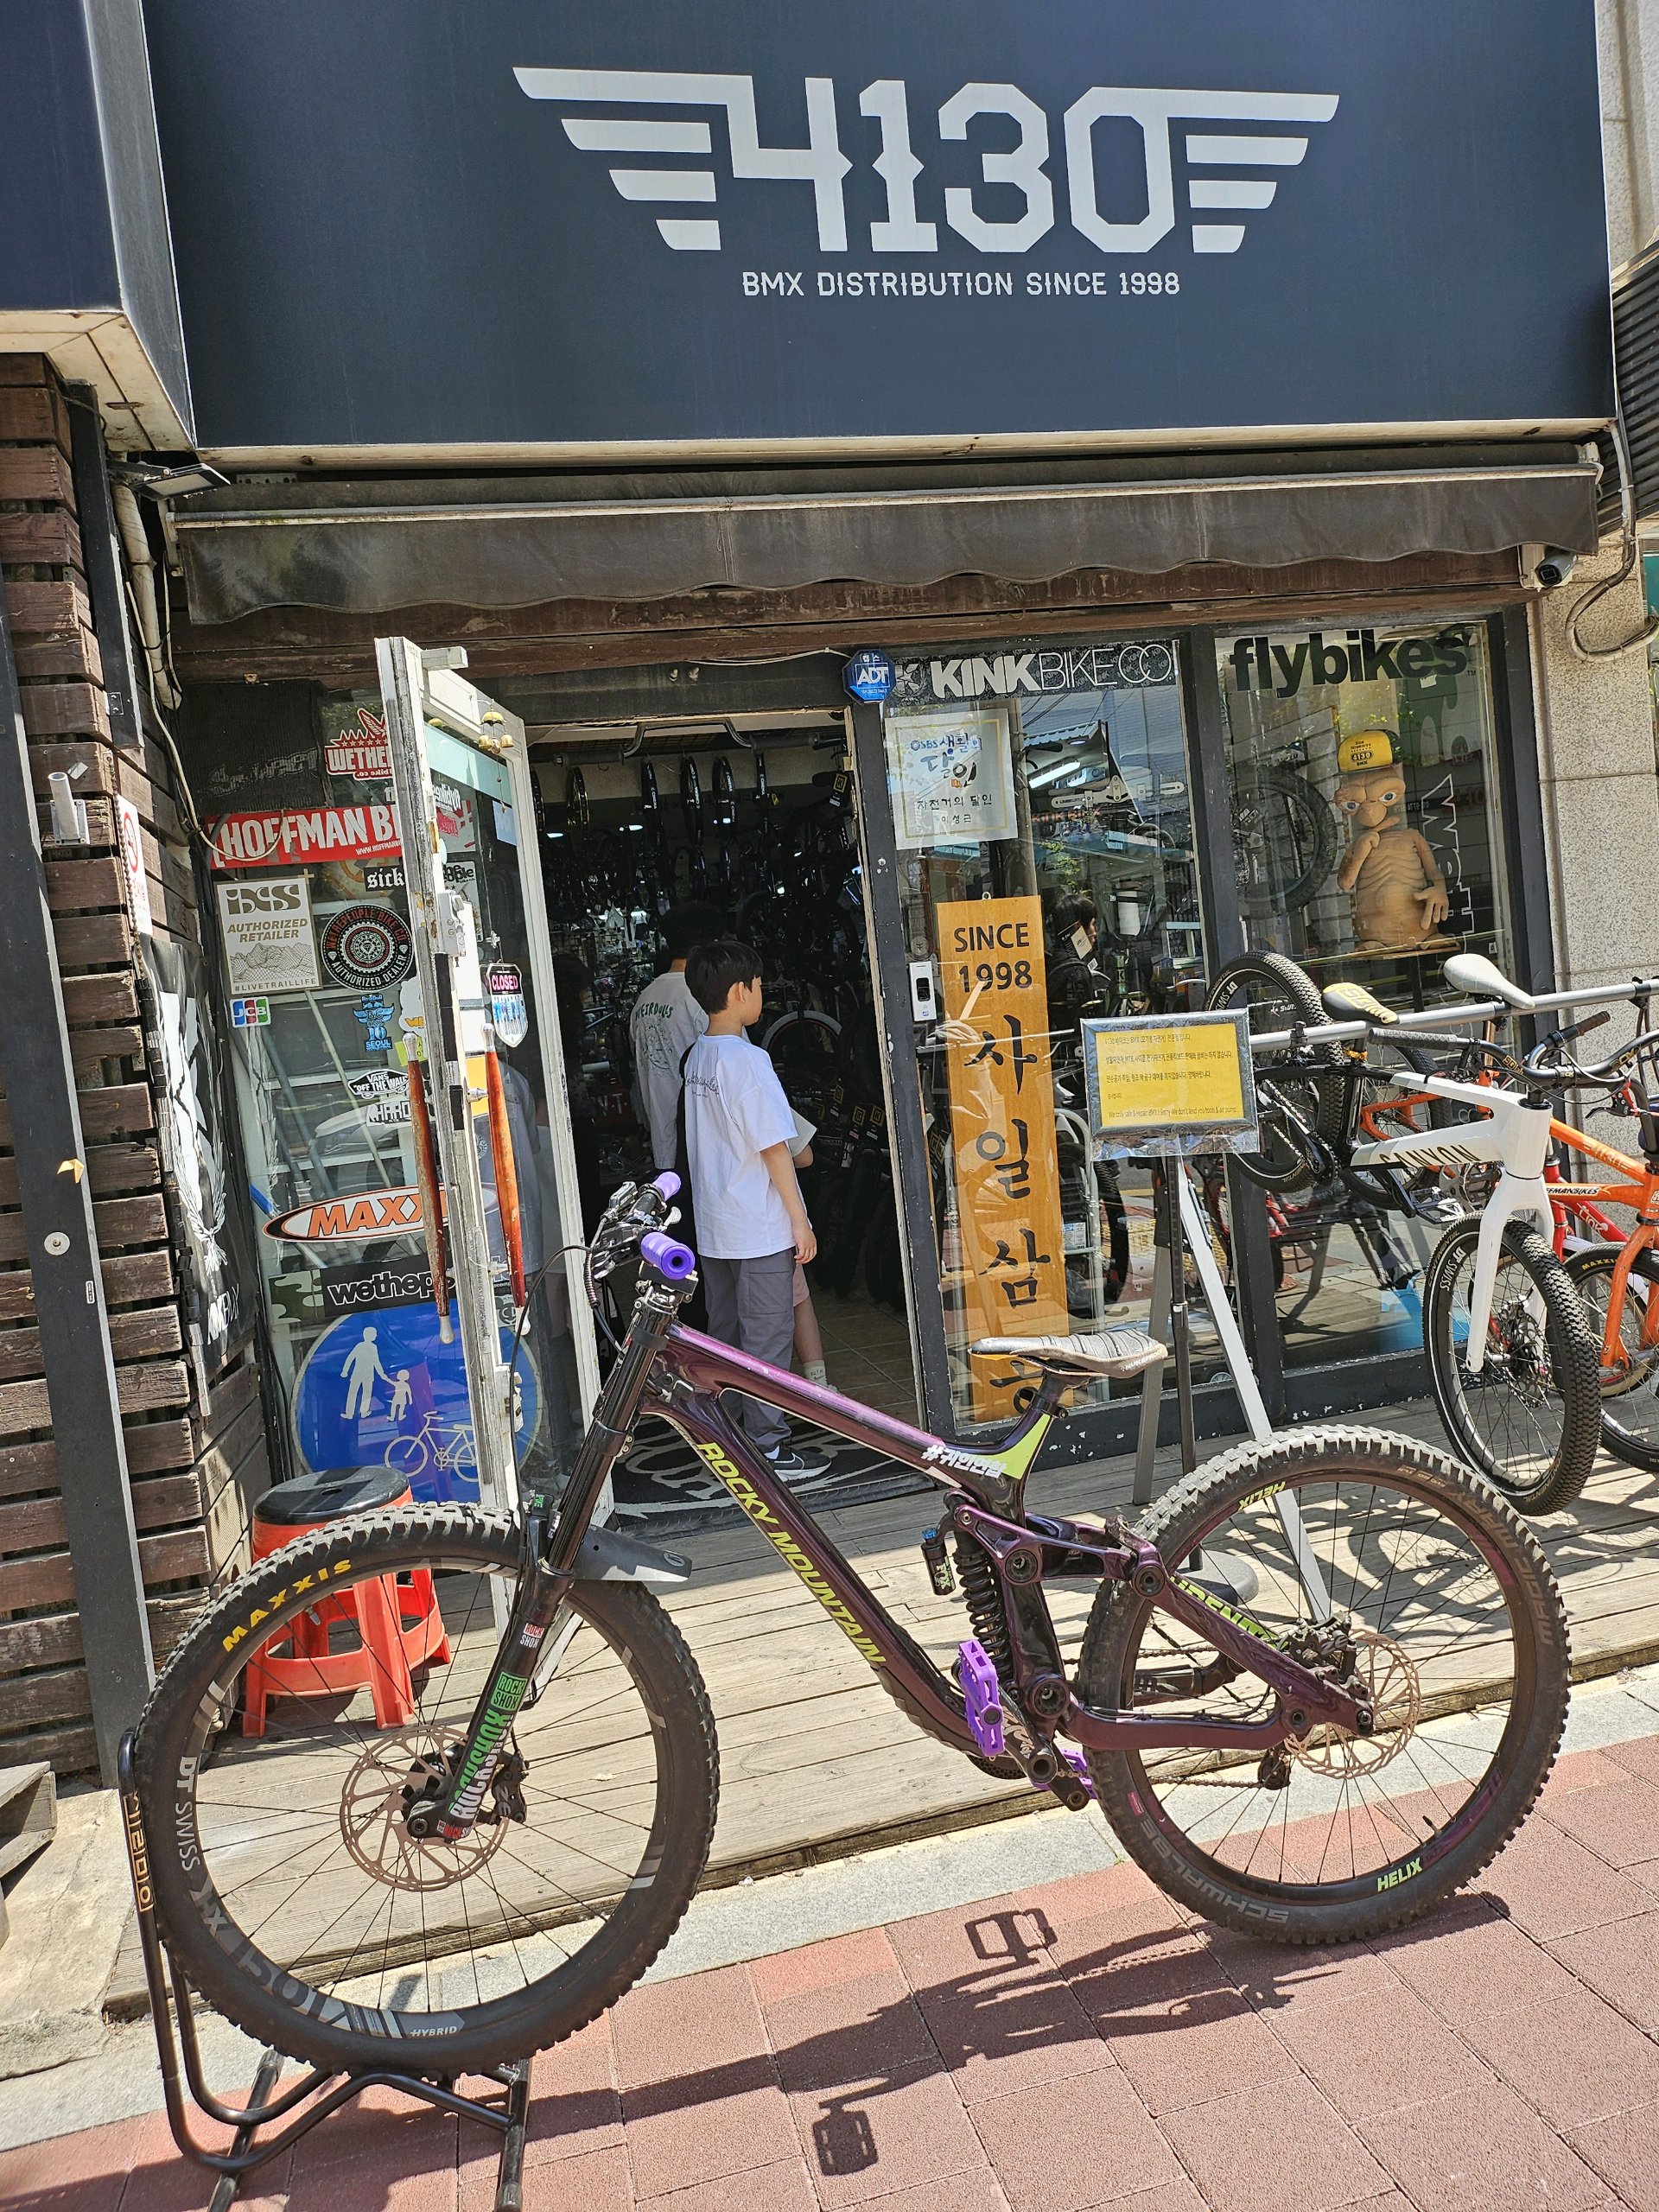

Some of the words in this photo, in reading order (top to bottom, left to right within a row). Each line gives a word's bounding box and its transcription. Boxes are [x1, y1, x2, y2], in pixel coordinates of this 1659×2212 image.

[727, 75, 1176, 253] 4130
[742, 271, 804, 296] BMX
[817, 271, 1014, 296] DISTRIBUTION
[1027, 272, 1107, 296] SINCE
[1119, 272, 1179, 296] 1998
[1230, 628, 1468, 698] flybikes
[857, 666, 888, 684] ADT
[931, 653, 1041, 699] KINK
[920, 740, 938, 749] SBS
[940, 733, 982, 754] 생활의
[327, 747, 392, 771] WETHE
[1351, 752, 1372, 760] 4130
[920, 752, 977, 787] 달인
[917, 796, 964, 810] 자전거의
[970, 794, 993, 807] 달인
[220, 808, 368, 861] HOFFMAN
[227, 918, 308, 933] AUTHORIZED
[377, 912, 397, 930] BIKE
[239, 930, 299, 943] RETAILER
[954, 923, 1030, 953] SINCE
[332, 962, 381, 987] AUTHORIZED
[383, 955, 407, 982] DEALER
[959, 961, 1033, 994] 1998
[235, 978, 316, 991] #LIVETRAILLIFE
[491, 975, 518, 991] CLOSED
[1227, 981, 1239, 995] DT
[232, 1004, 269, 1020] JCB
[367, 1071, 390, 1083] VANS
[371, 1080, 389, 1091] THE
[1379, 1144, 1480, 1166] CANYON
[307, 1195, 425, 1238] MAXX
[1452, 1246, 1467, 1264] DT
[1581, 1258, 1618, 1270] MAXXI
[1440, 1261, 1459, 1292] SWISS
[1238, 1481, 1286, 1510] HELIX
[697, 1442, 779, 1525] ROCKY
[768, 1530, 887, 1663] MOUNTAIN
[935, 1564, 951, 1589] FOX
[222, 1559, 353, 1653] MAXXIS
[520, 1634, 540, 1649] SHOX
[524, 1624, 544, 1638] ROCK
[497, 1675, 526, 1695] ROCK
[493, 1691, 520, 1710] SHOX
[176, 1756, 200, 1793] DT
[175, 1801, 200, 1872] SWISS
[1141, 1820, 1289, 1924] SCHWALBE
[1376, 1857, 1423, 1892] HELIX
[410, 2024, 458, 2037] HYBRID
